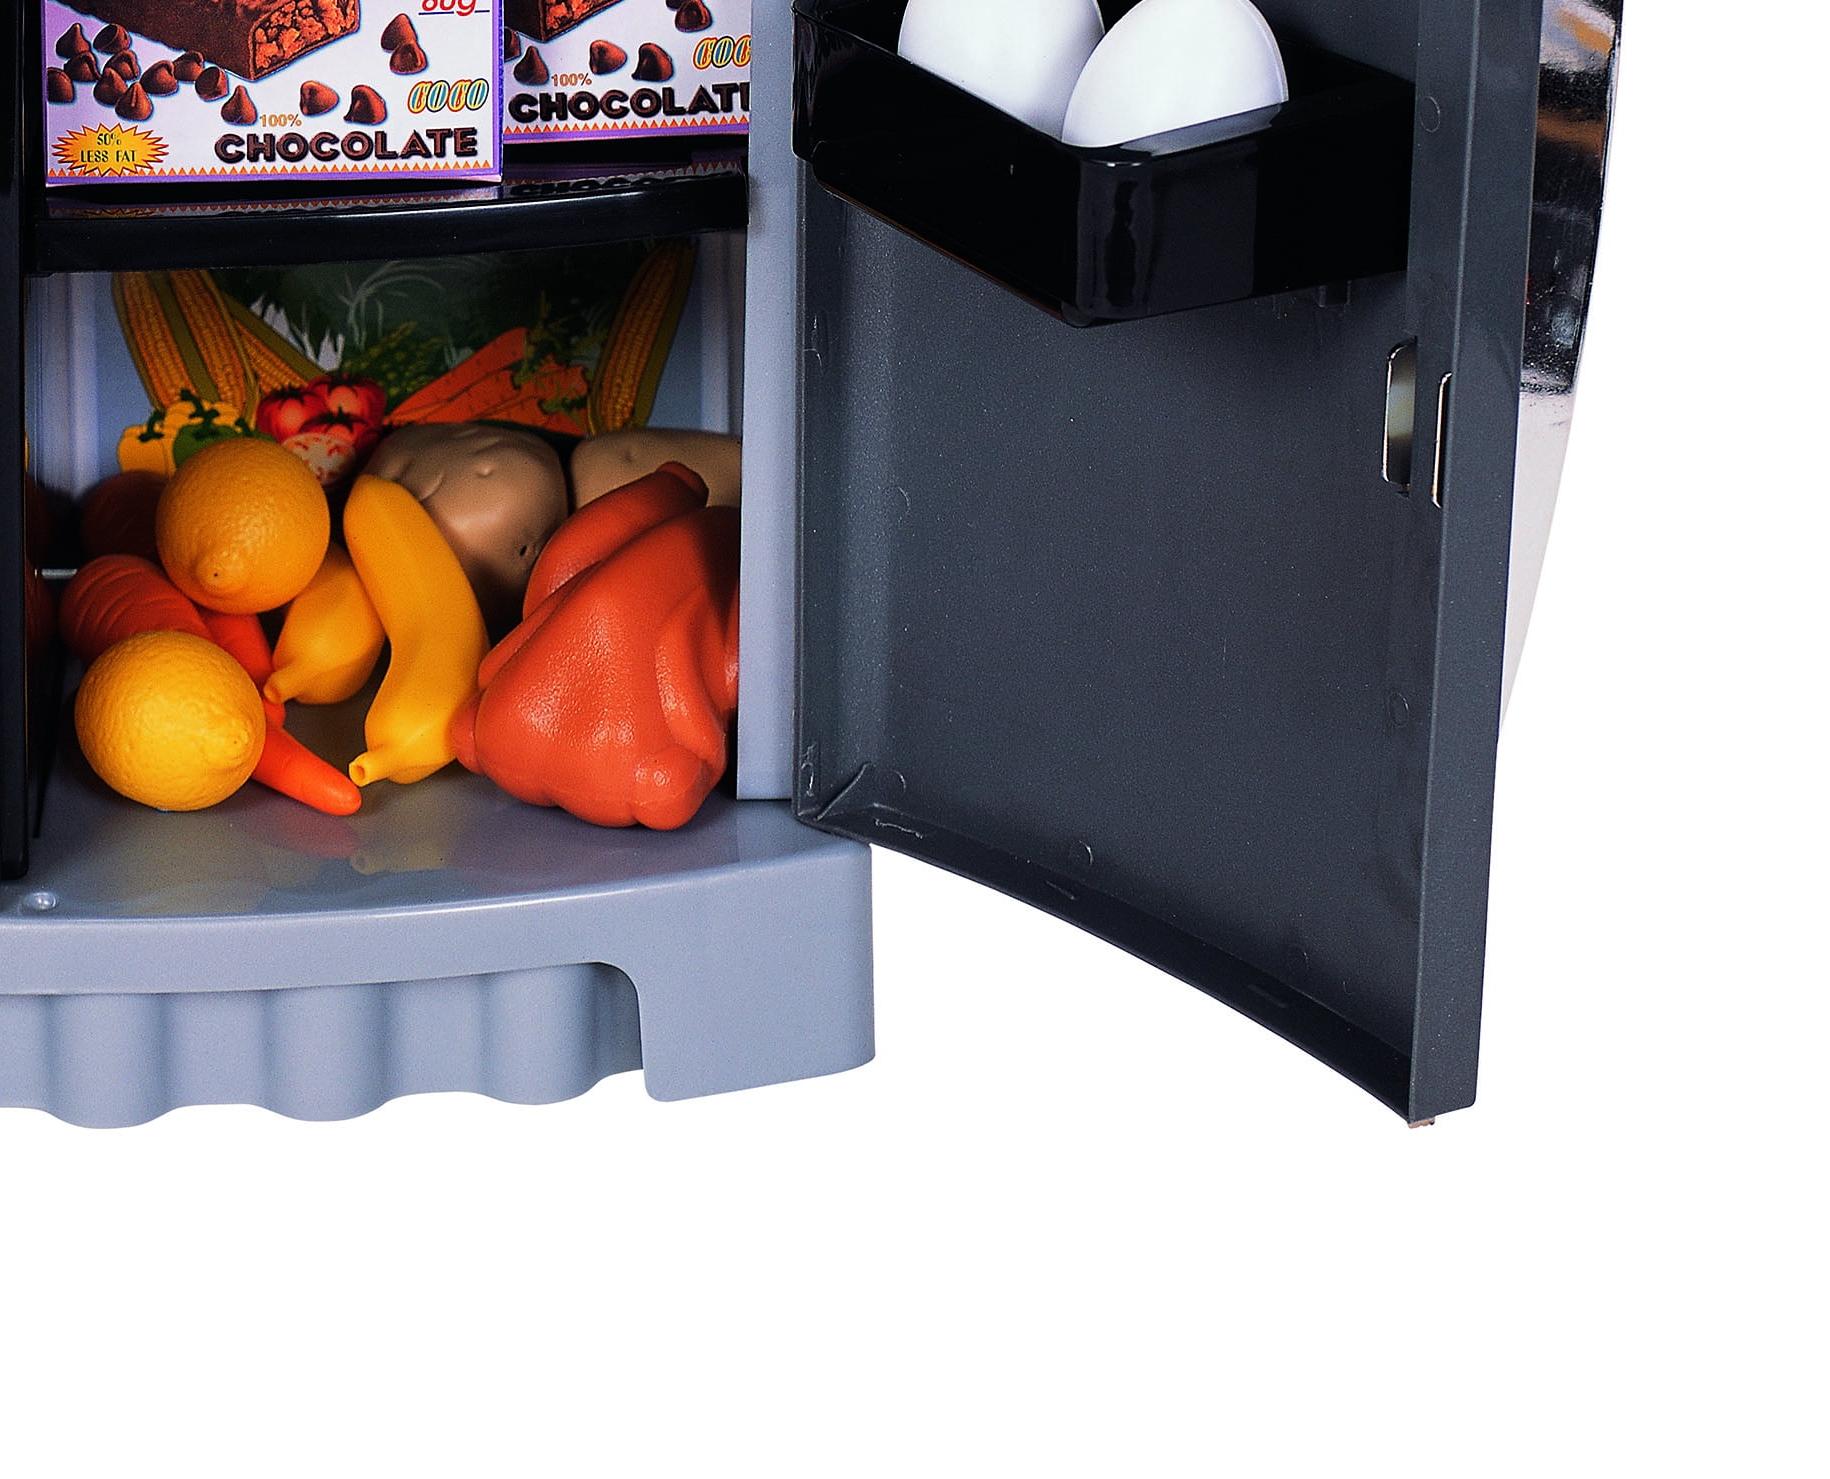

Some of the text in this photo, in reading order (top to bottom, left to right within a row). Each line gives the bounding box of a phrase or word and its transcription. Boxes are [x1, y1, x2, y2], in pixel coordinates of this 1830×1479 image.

[692, 34, 752, 70] COC
[551, 73, 593, 87] 100%
[407, 77, 490, 114] COCO
[258, 113, 303, 128] 100%
[96, 132, 122, 147] 50%
[214, 126, 479, 163] CHOCOLATE
[80, 149, 137, 163] LESS FAT
